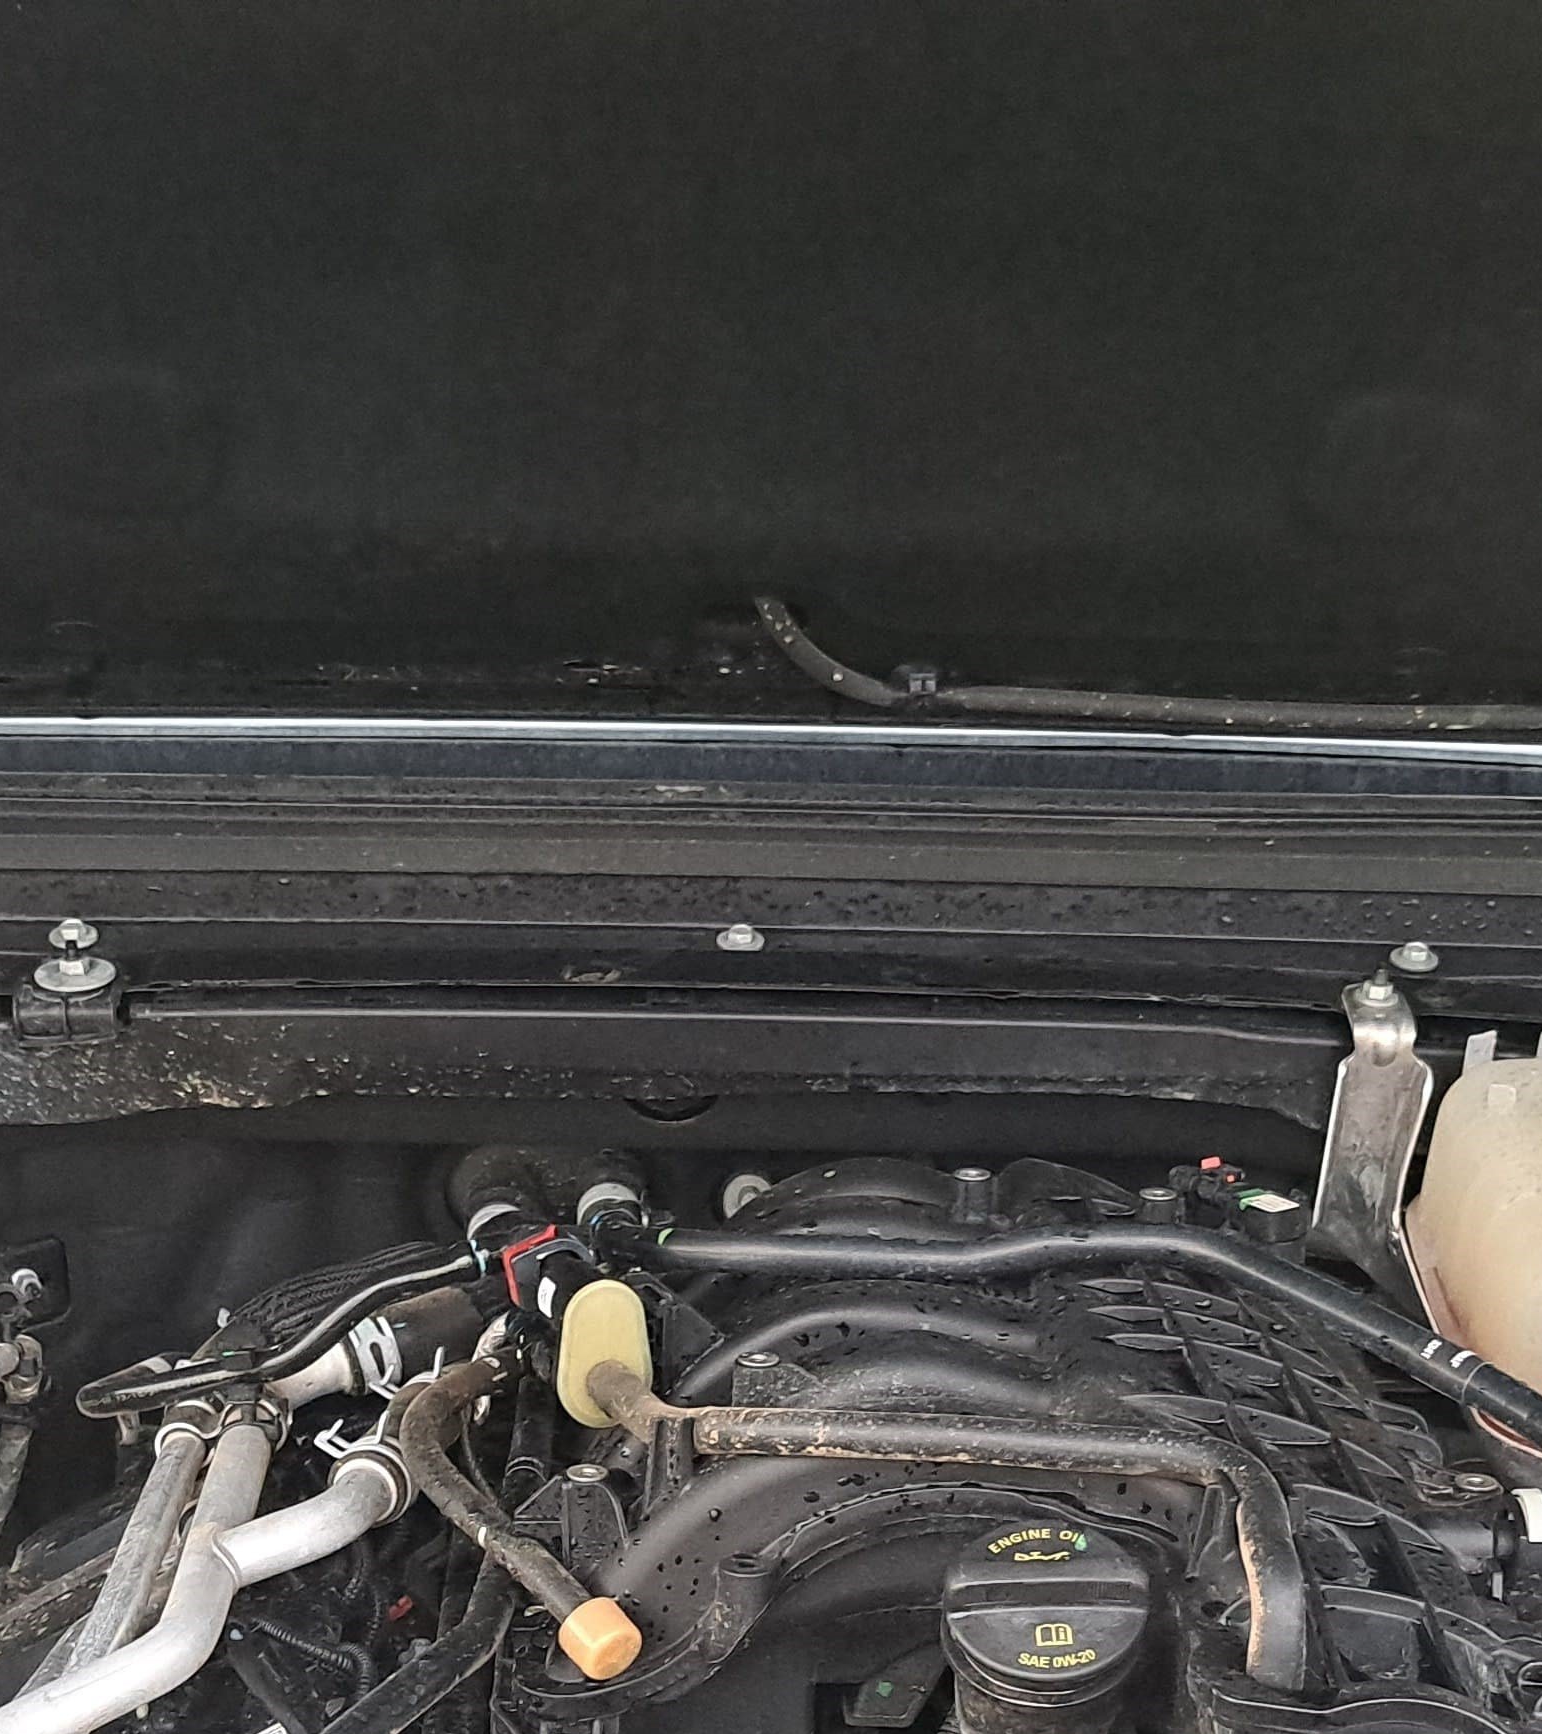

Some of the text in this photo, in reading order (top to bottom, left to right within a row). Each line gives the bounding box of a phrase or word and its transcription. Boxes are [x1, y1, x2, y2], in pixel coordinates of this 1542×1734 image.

[988, 1528, 1087, 1554] ENGINE OI
[1018, 1648, 1096, 1668] SAE 0W-20
